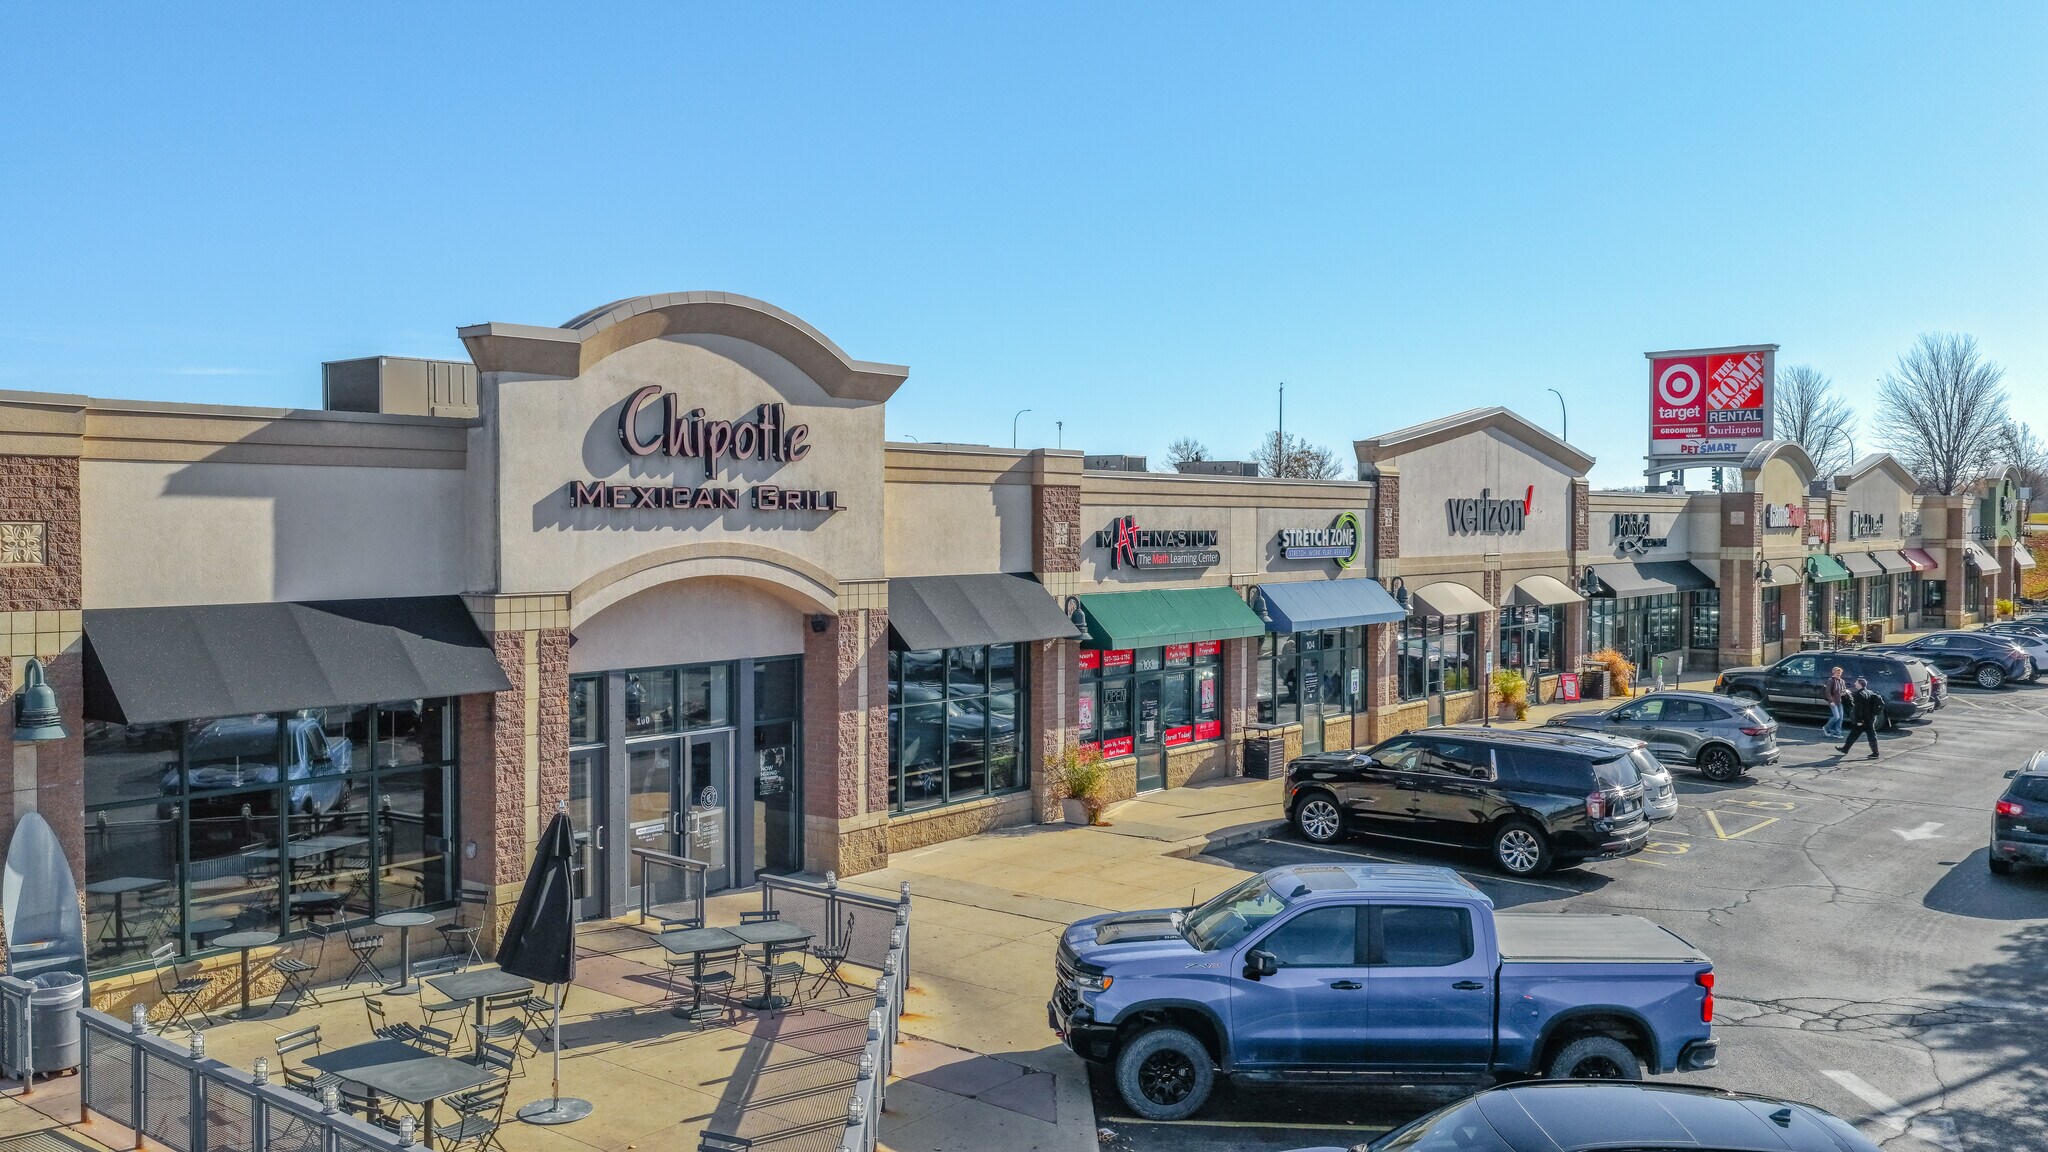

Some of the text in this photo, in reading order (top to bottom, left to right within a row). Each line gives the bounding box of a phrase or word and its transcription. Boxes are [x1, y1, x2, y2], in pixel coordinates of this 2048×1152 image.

[1712, 358, 1736, 383] THE
[1708, 352, 1764, 410] HOME
[1659, 405, 1700, 421] target
[1709, 410, 1761, 422] RENTAL
[618, 385, 811, 480] Chipotle
[1660, 427, 1698, 435] GROOMING
[1708, 425, 1762, 438] Burlington
[570, 480, 847, 511] MEXICAN GRILL
[1446, 488, 1526, 532] verizon
[1282, 528, 1355, 547] STRETCH ZONE
[1139, 551, 1218, 566] The Math Learning Center
[1306, 640, 1315, 649] 104
[1106, 689, 1126, 702] OPEN
[1178, 731, 1192, 739] Today!
